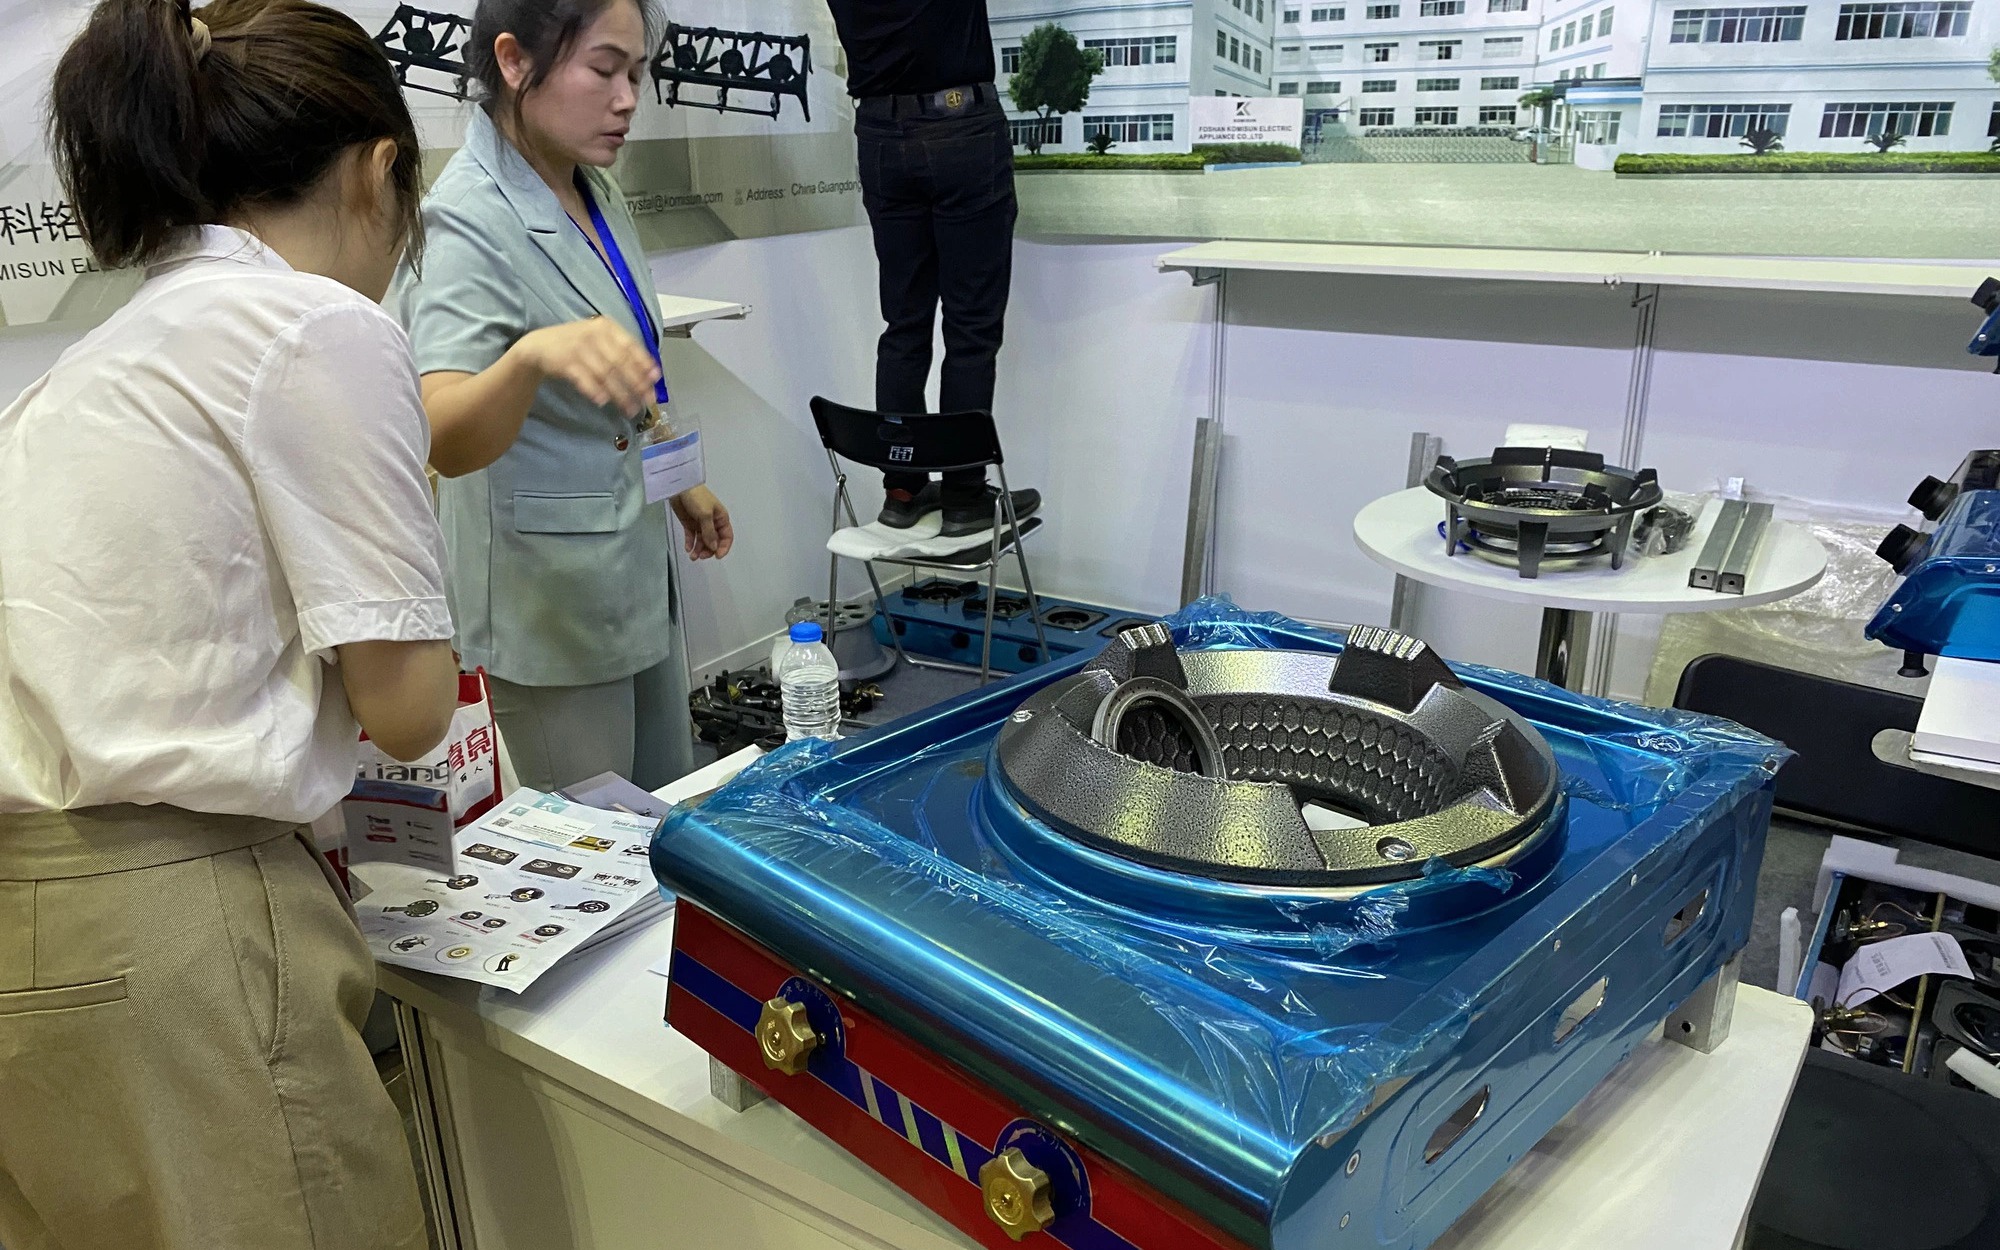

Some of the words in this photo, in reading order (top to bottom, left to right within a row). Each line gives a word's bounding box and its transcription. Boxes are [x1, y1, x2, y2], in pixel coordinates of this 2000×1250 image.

[624, 191, 724, 216] rystal@komisun.com
[791, 182, 816, 196] China
[71, 257, 114, 274] EL
